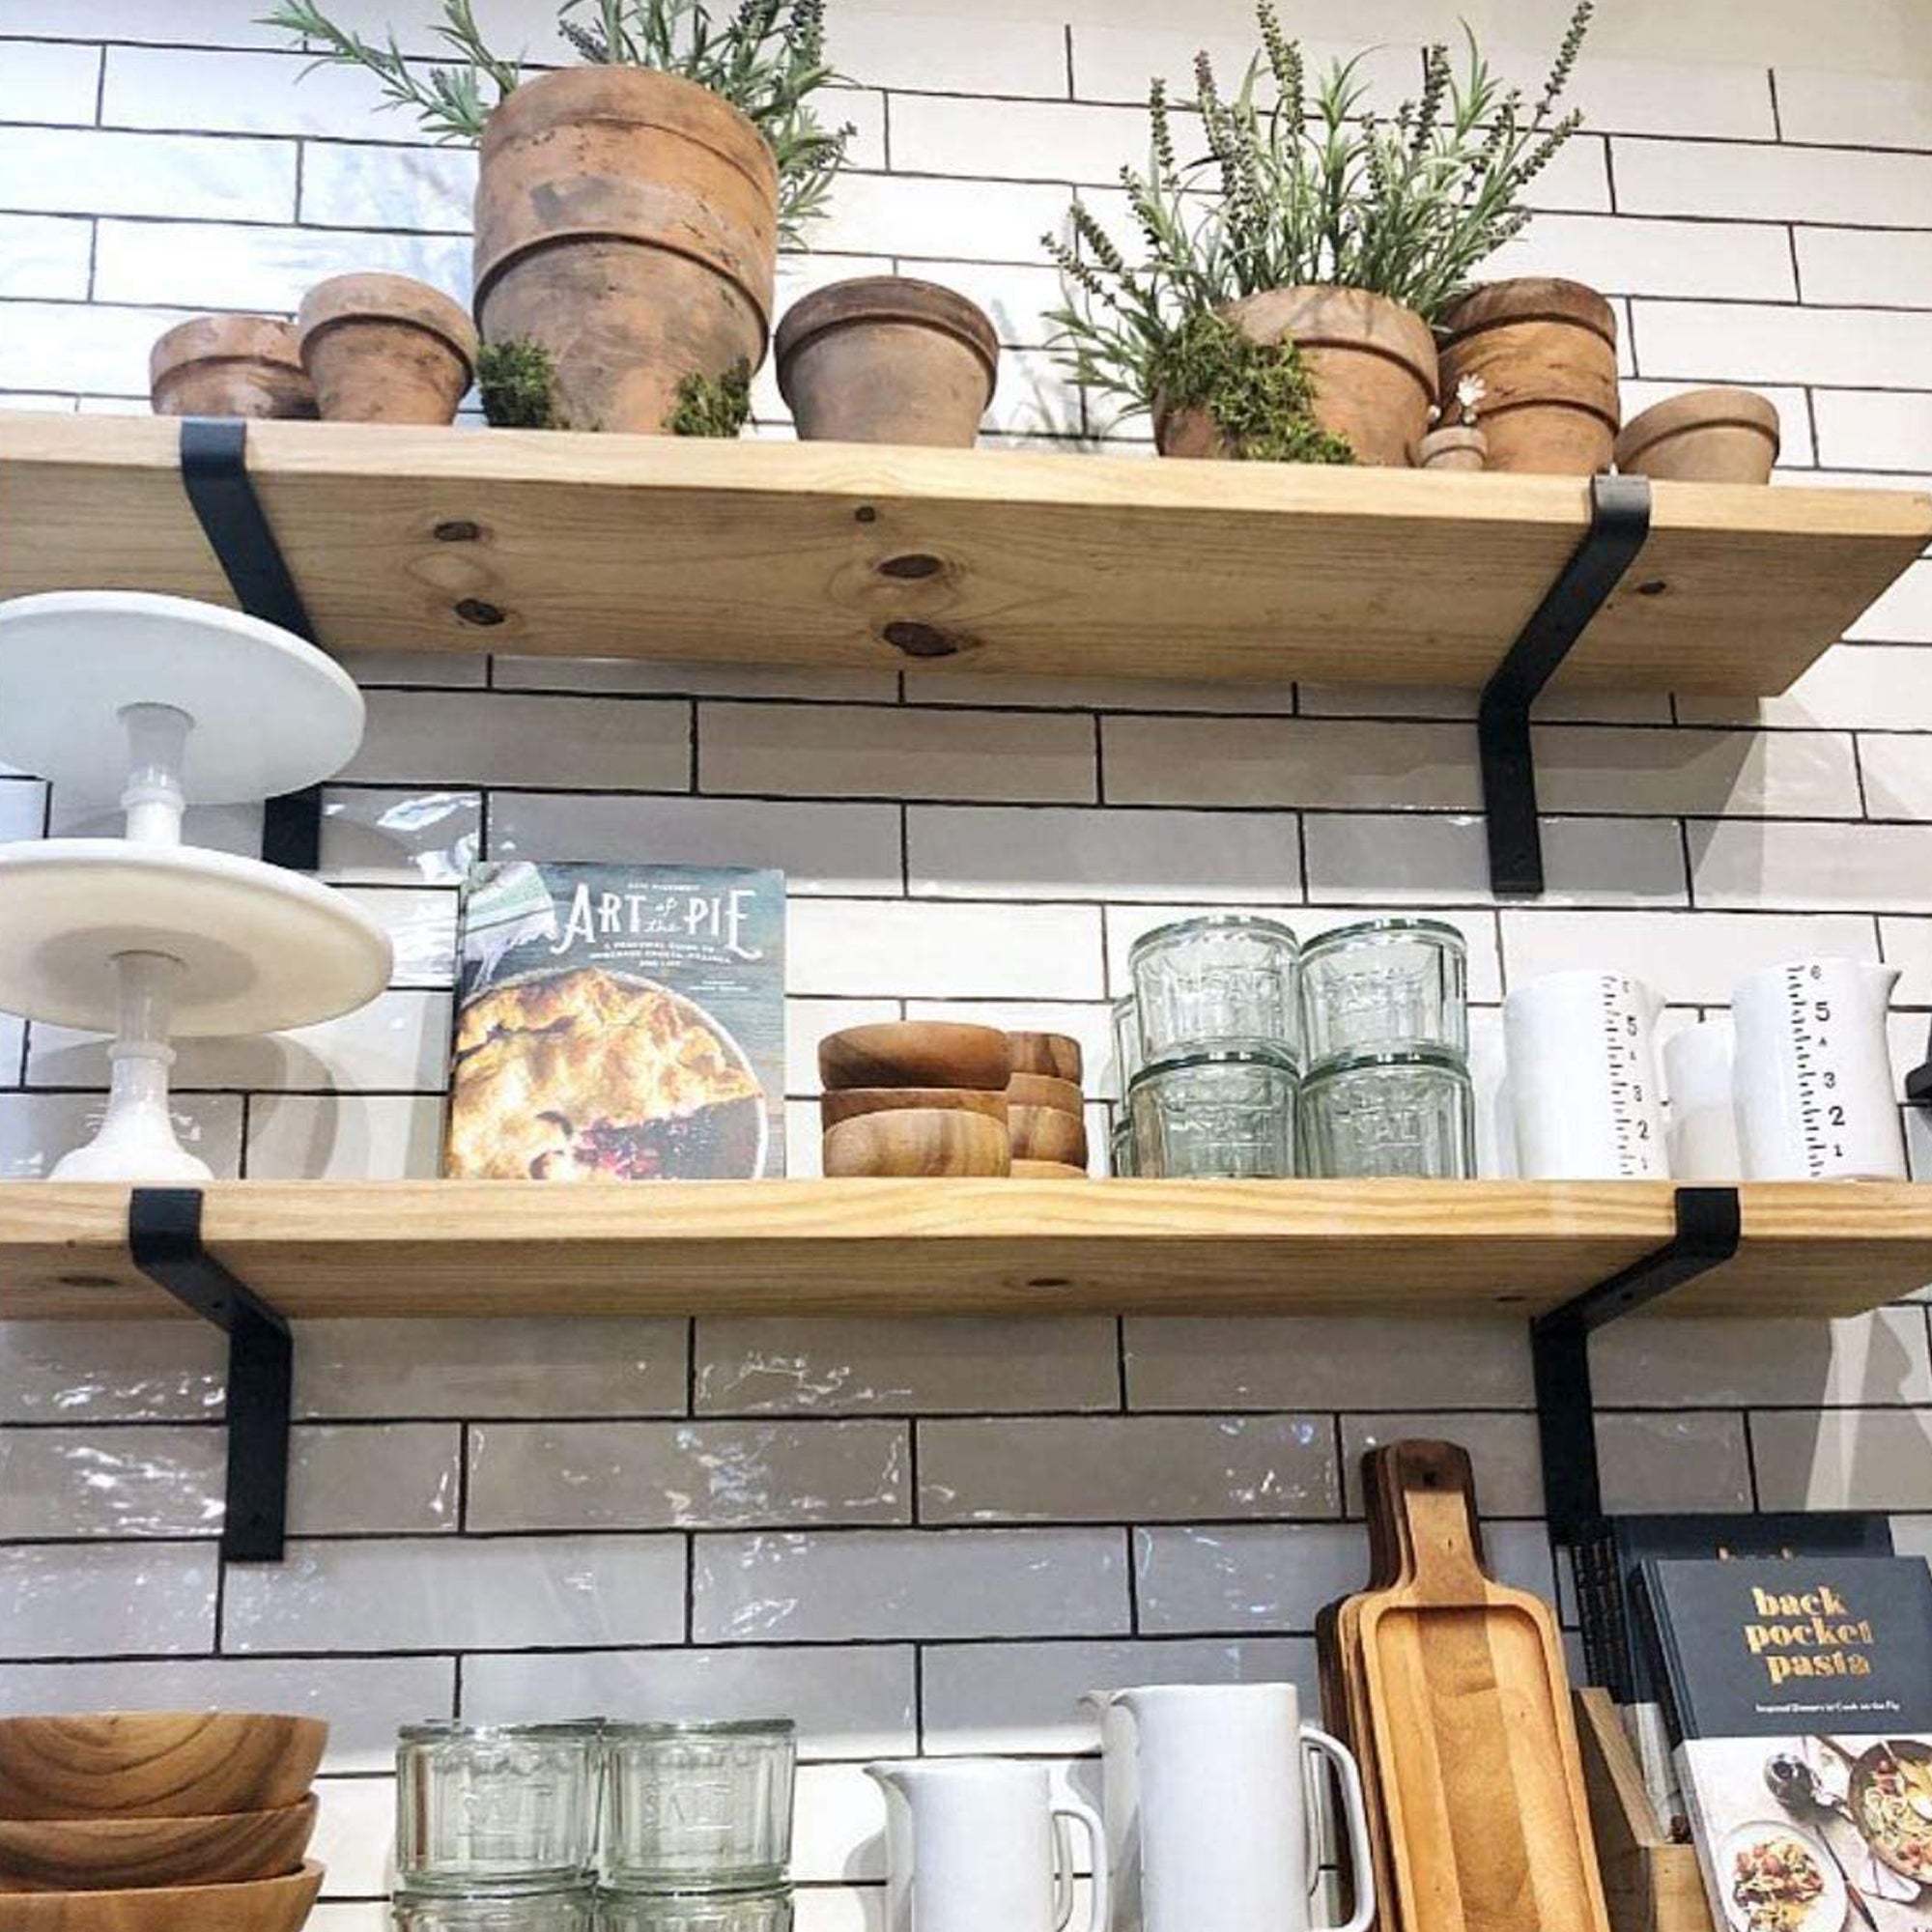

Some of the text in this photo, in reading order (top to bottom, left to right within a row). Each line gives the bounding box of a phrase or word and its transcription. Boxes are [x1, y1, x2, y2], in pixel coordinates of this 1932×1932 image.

[550, 883, 762, 960] ART of the PIE
[1815, 1001, 1831, 1022] 5
[1627, 1015, 1637, 1037] 5
[1823, 1071, 1835, 1089] 3
[1829, 1105, 1846, 1126] 2
[1637, 1119, 1650, 1140] 2
[1833, 1144, 1843, 1157] 1
[1751, 1585, 1849, 1616] back
[1744, 1616, 1874, 1654] pocket
[1766, 1651, 1870, 1685] pasta
